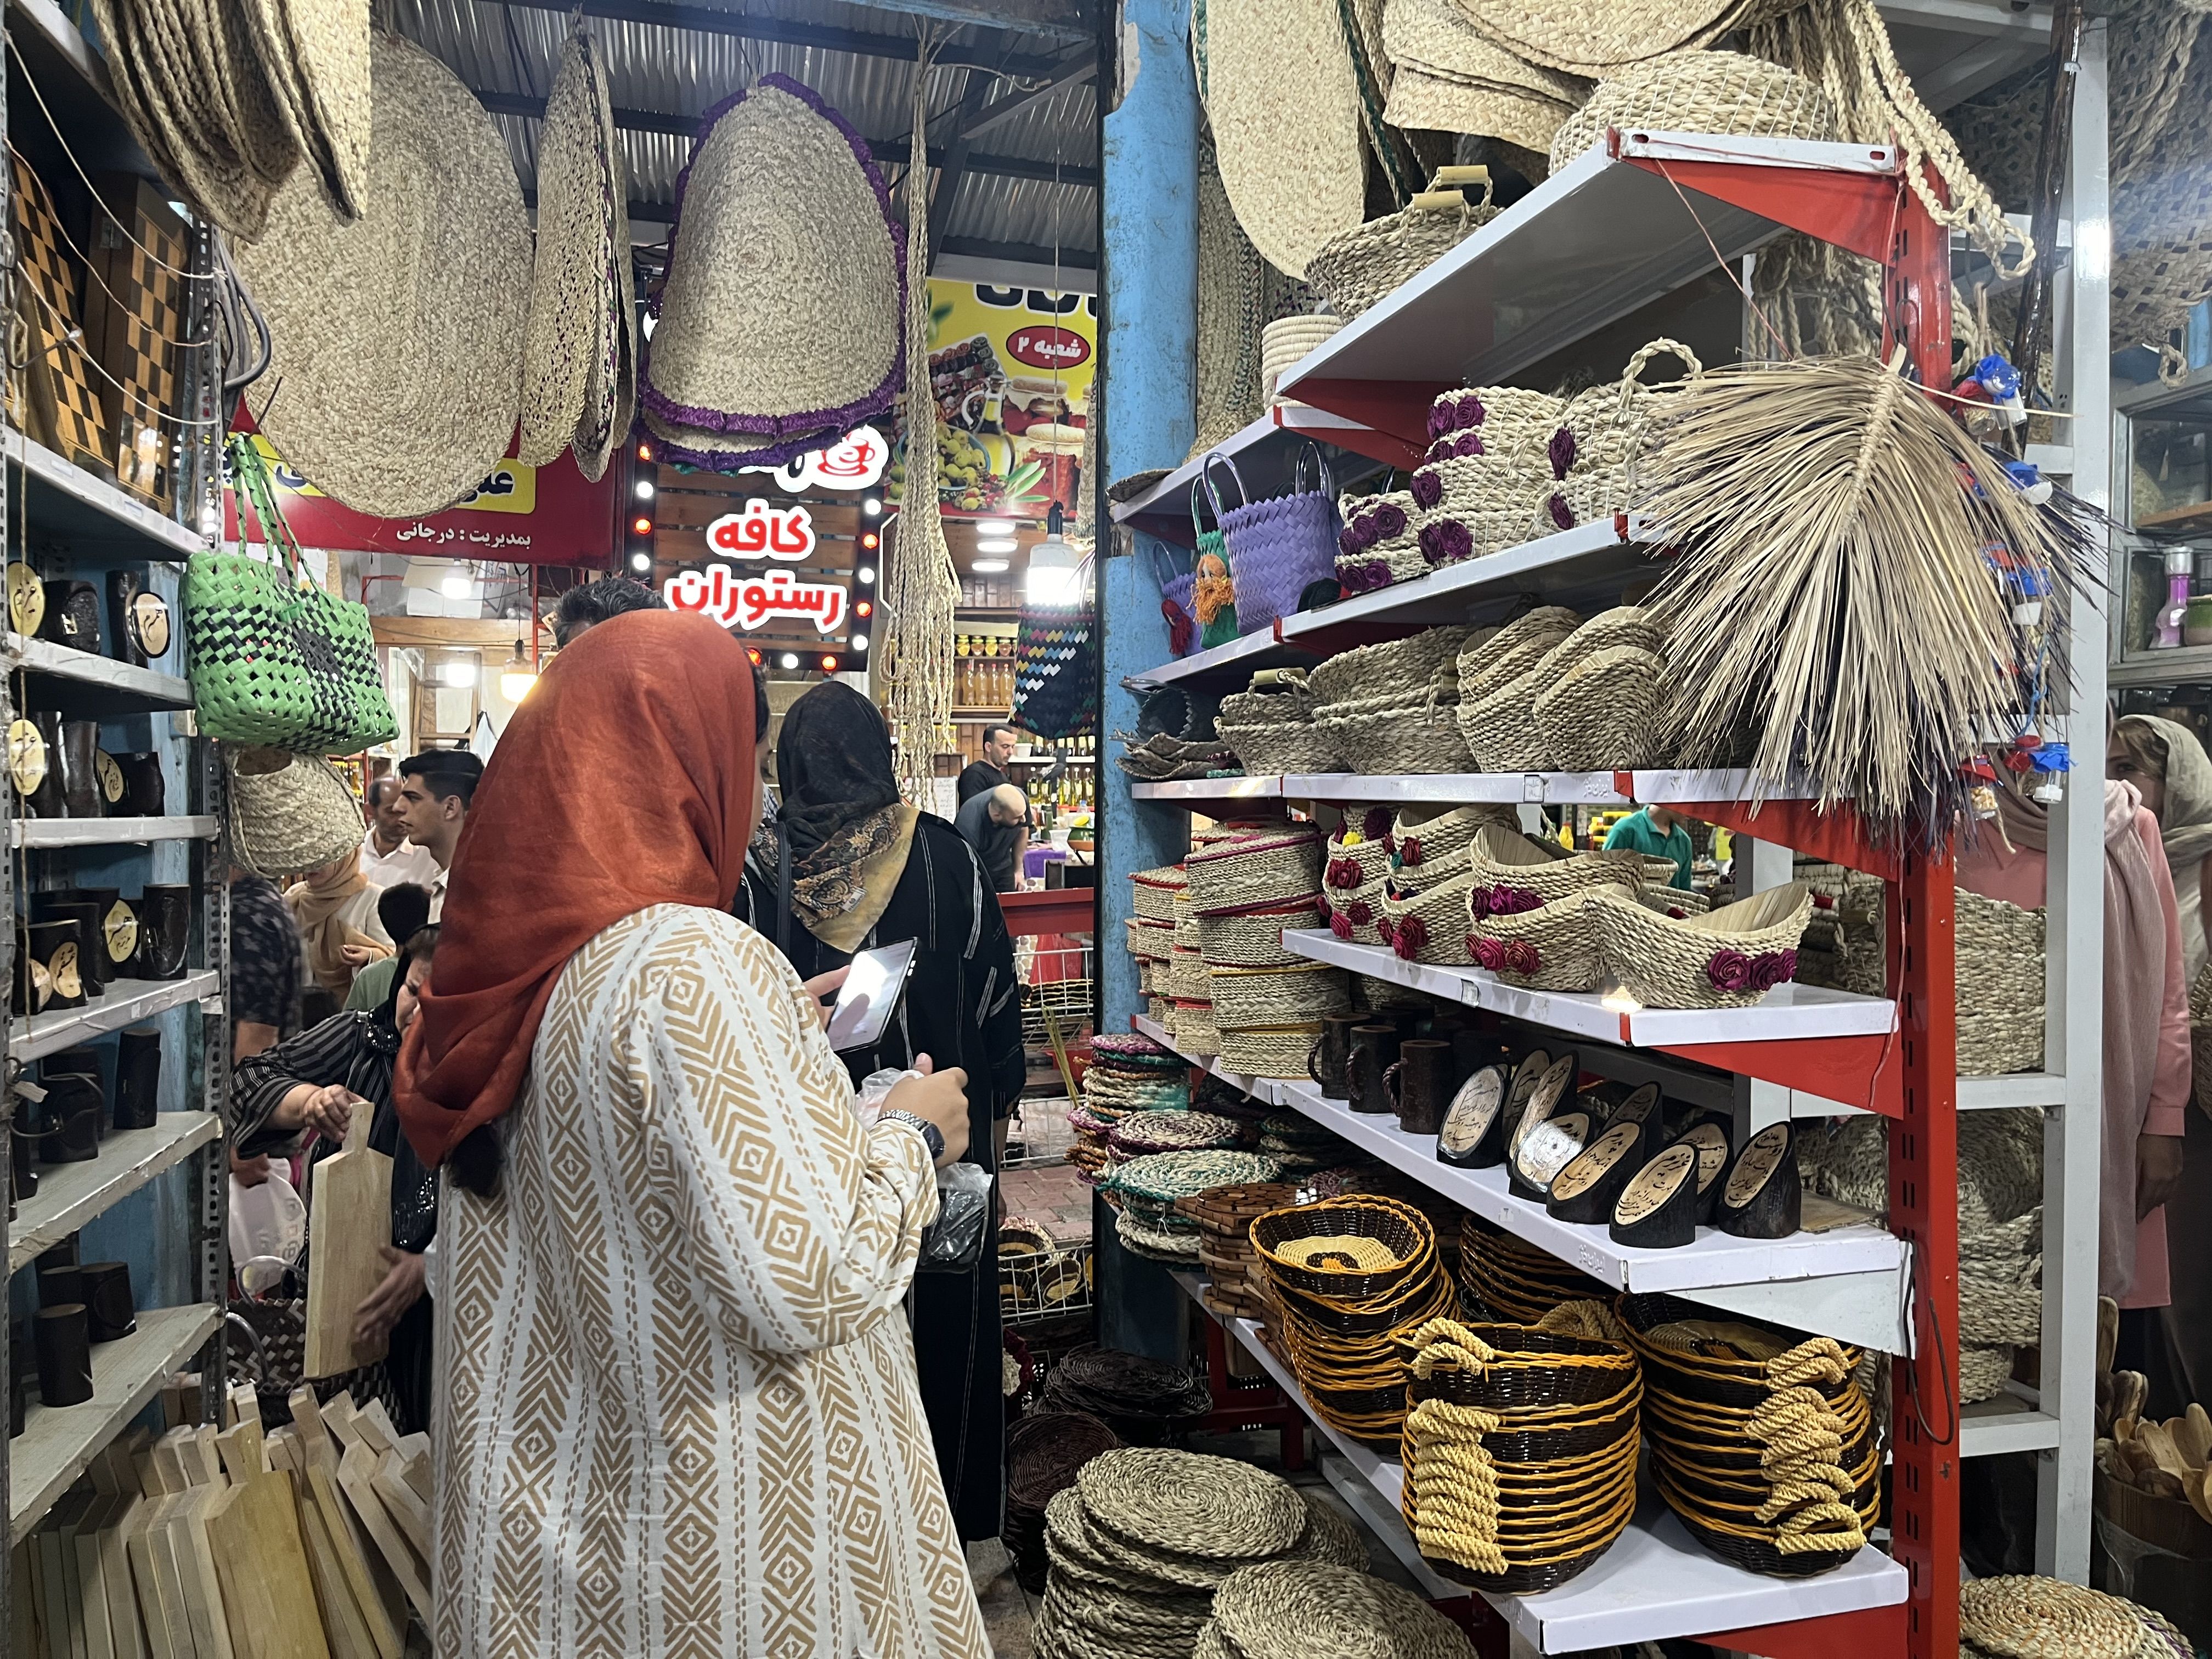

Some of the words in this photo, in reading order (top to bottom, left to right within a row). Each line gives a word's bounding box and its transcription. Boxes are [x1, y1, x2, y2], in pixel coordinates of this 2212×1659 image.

[1034, 338, 1081, 359] شعبه
[469, 529, 532, 550] بمدیریت
[715, 501, 808, 553] کافه
[672, 572, 840, 625] رستوران
